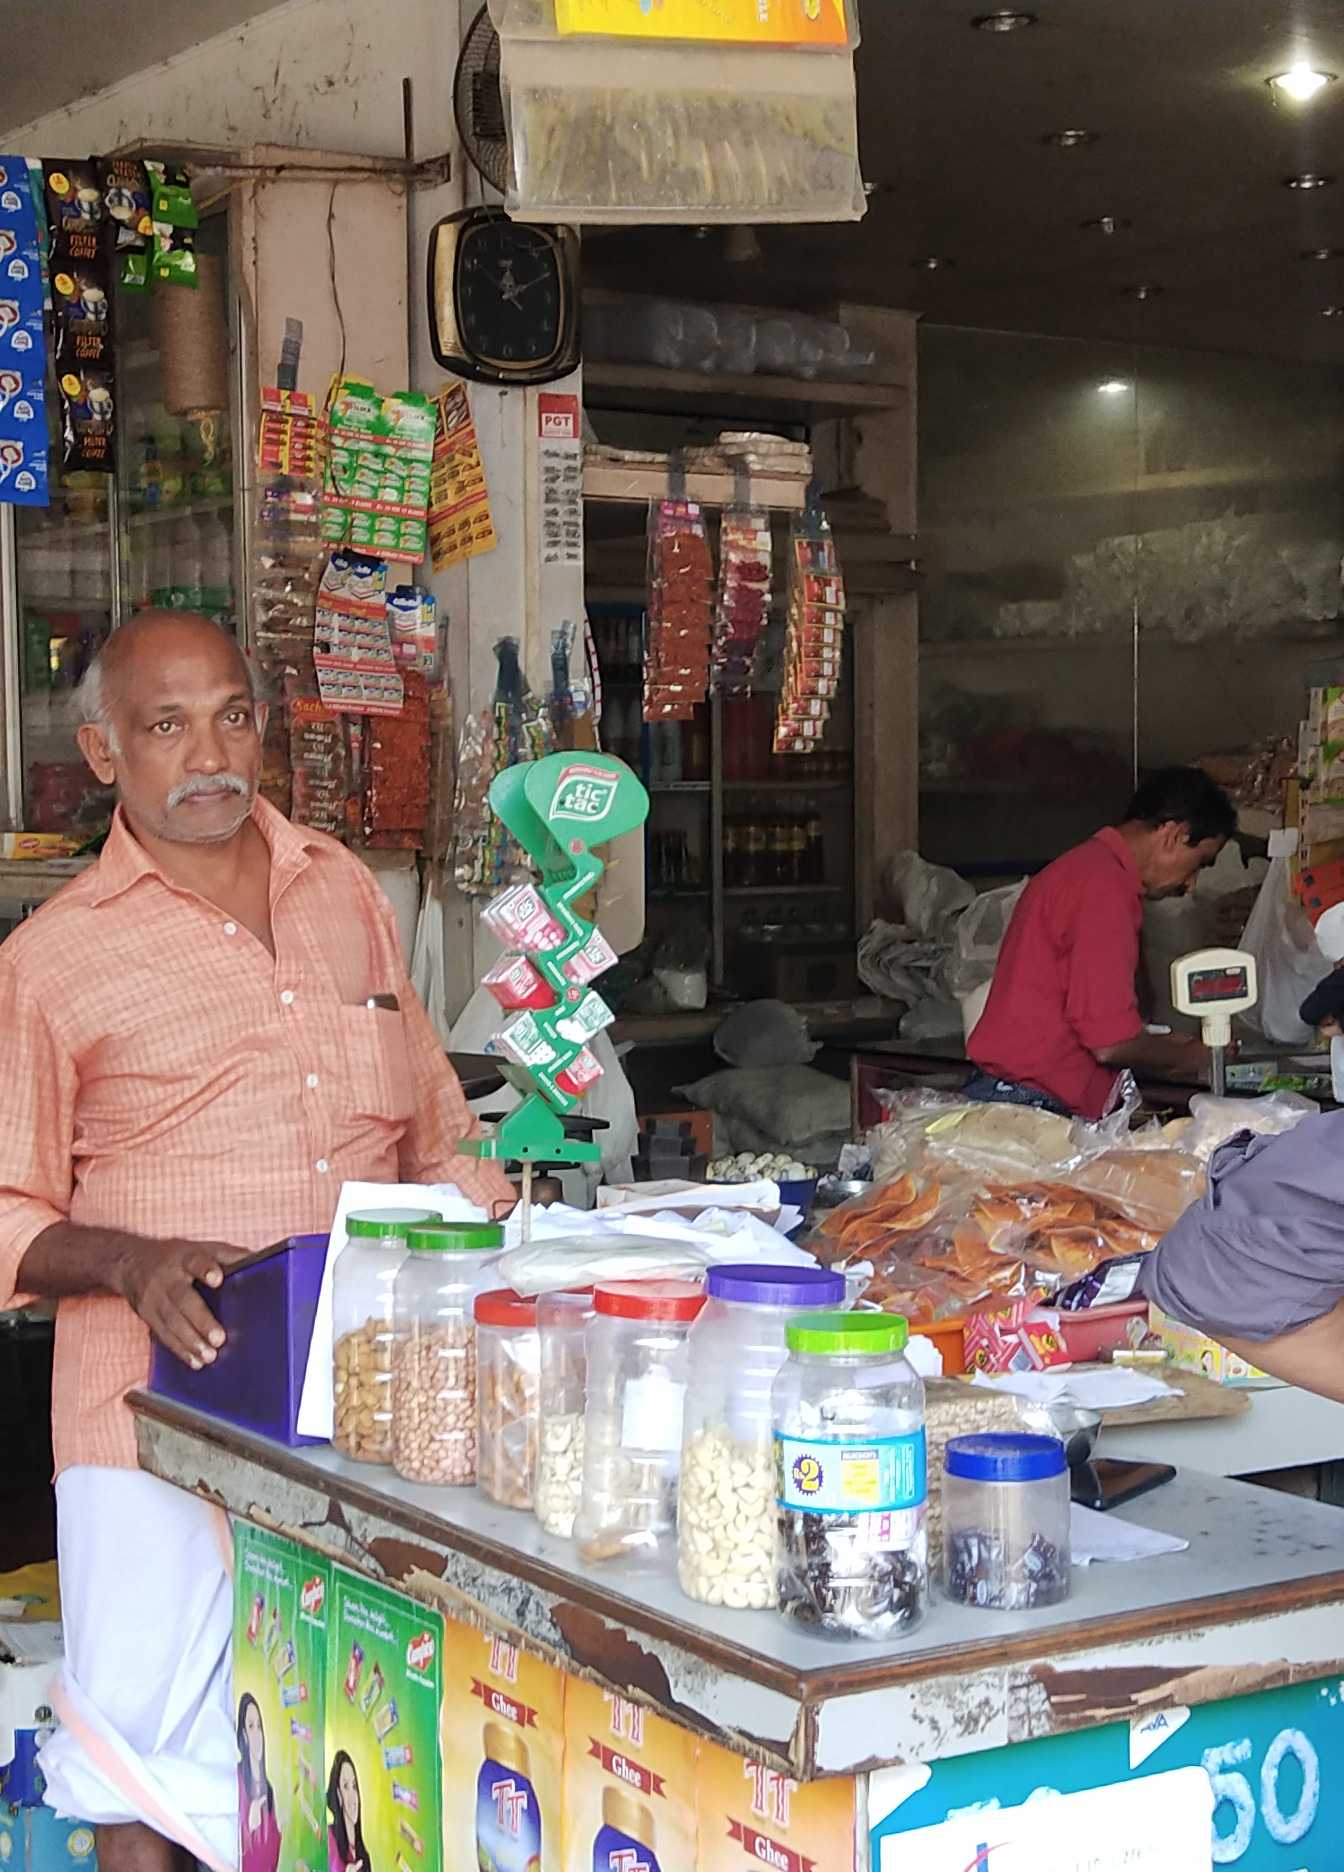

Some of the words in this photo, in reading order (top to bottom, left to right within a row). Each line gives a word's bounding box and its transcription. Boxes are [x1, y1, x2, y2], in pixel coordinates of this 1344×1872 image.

[69, 234, 96, 248] FILTER
[545, 415, 571, 428] PGT
[564, 795, 600, 814] tac
[575, 783, 604, 800] tic
[800, 1458, 820, 1491] 2
[490, 1692, 519, 1722] Ghee
[611, 1755, 642, 1789] Ghee
[492, 1778, 528, 1836] TT
[743, 1757, 798, 1829] TT
[754, 1836, 790, 1870] Ghee
